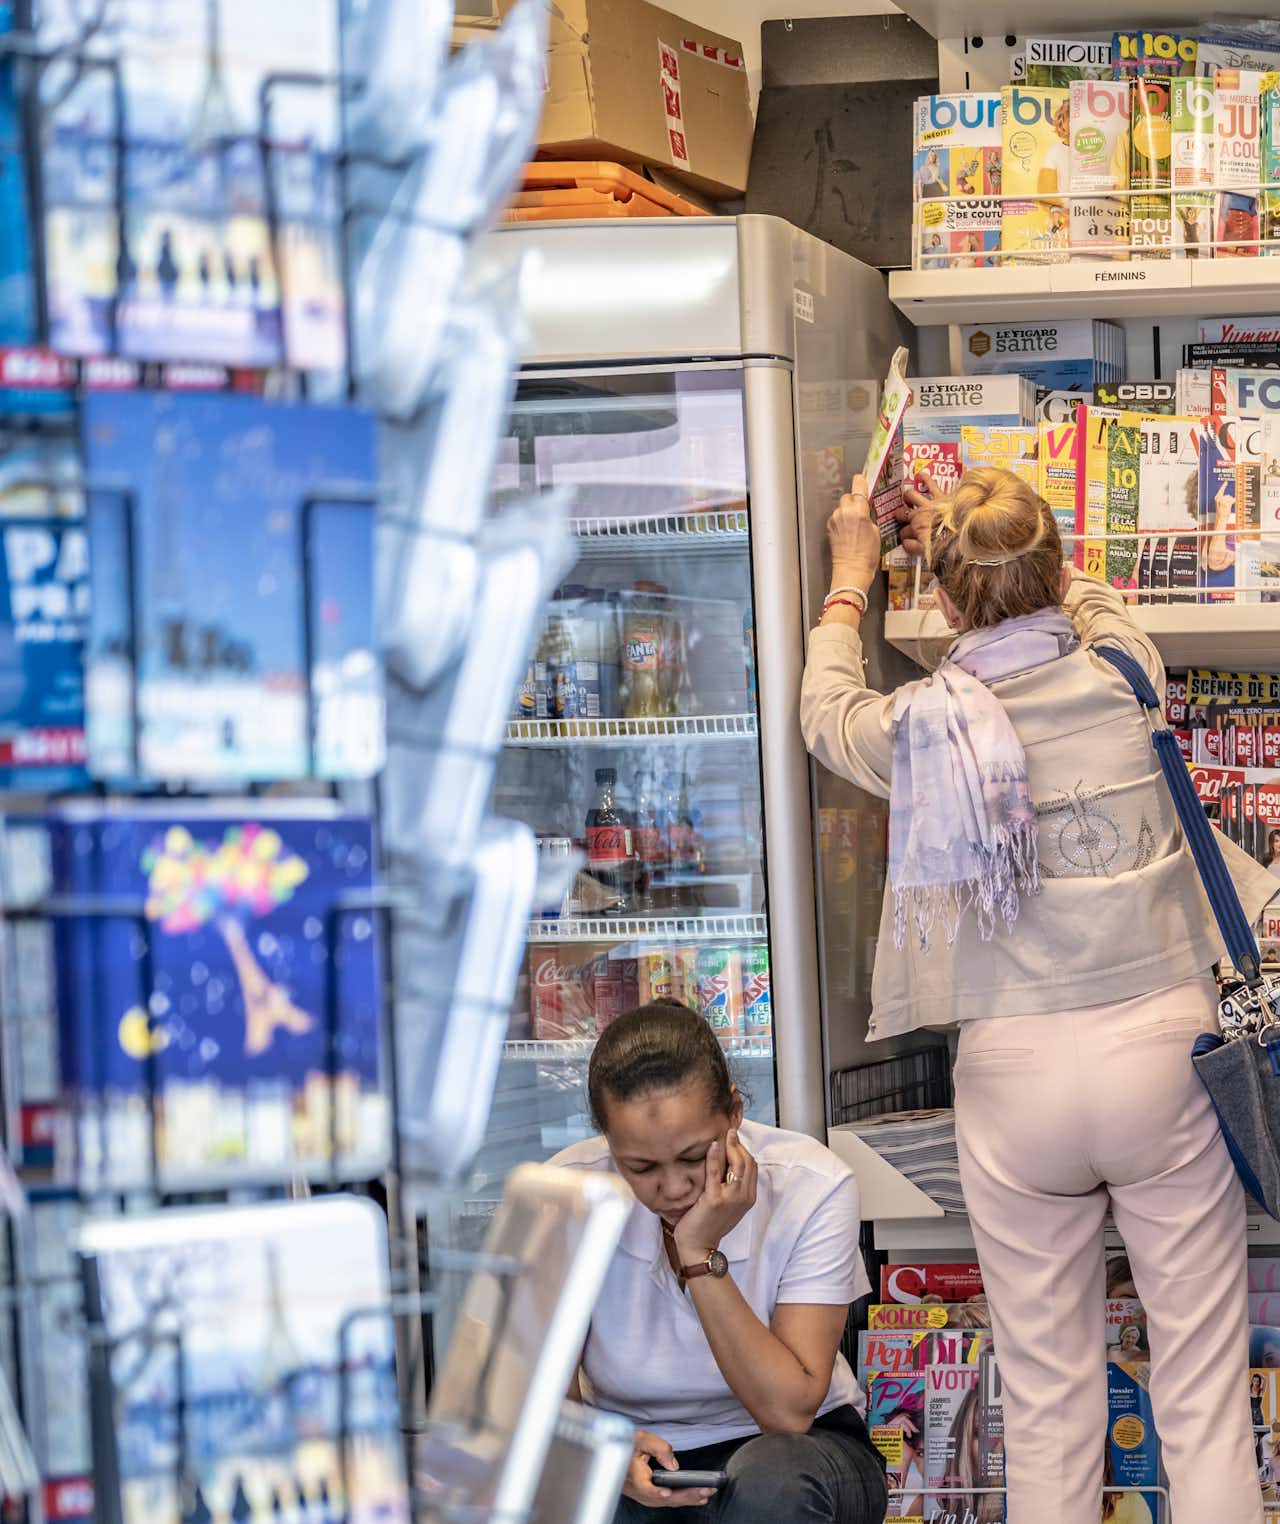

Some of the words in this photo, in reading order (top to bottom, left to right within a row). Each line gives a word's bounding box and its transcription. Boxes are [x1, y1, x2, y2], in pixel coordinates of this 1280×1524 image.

[1073, 205, 1103, 217] Belle
[1095, 271, 1146, 282] FÉMININS
[996, 330, 1010, 339] LE
[1011, 328, 1057, 339] FIGARO
[920, 385, 935, 394] LE
[936, 384, 983, 393] FIGARO
[912, 445, 940, 458] TOP
[933, 462, 956, 475] TOP
[1110, 467, 1136, 490] 10
[1087, 549, 1103, 558] ET
[625, 641, 656, 659] FANTA
[1191, 677, 1243, 697] SCÈNES
[1248, 681, 1264, 697] DE
[1258, 806, 1274, 817] DE
[706, 1015, 730, 1027] TEA
